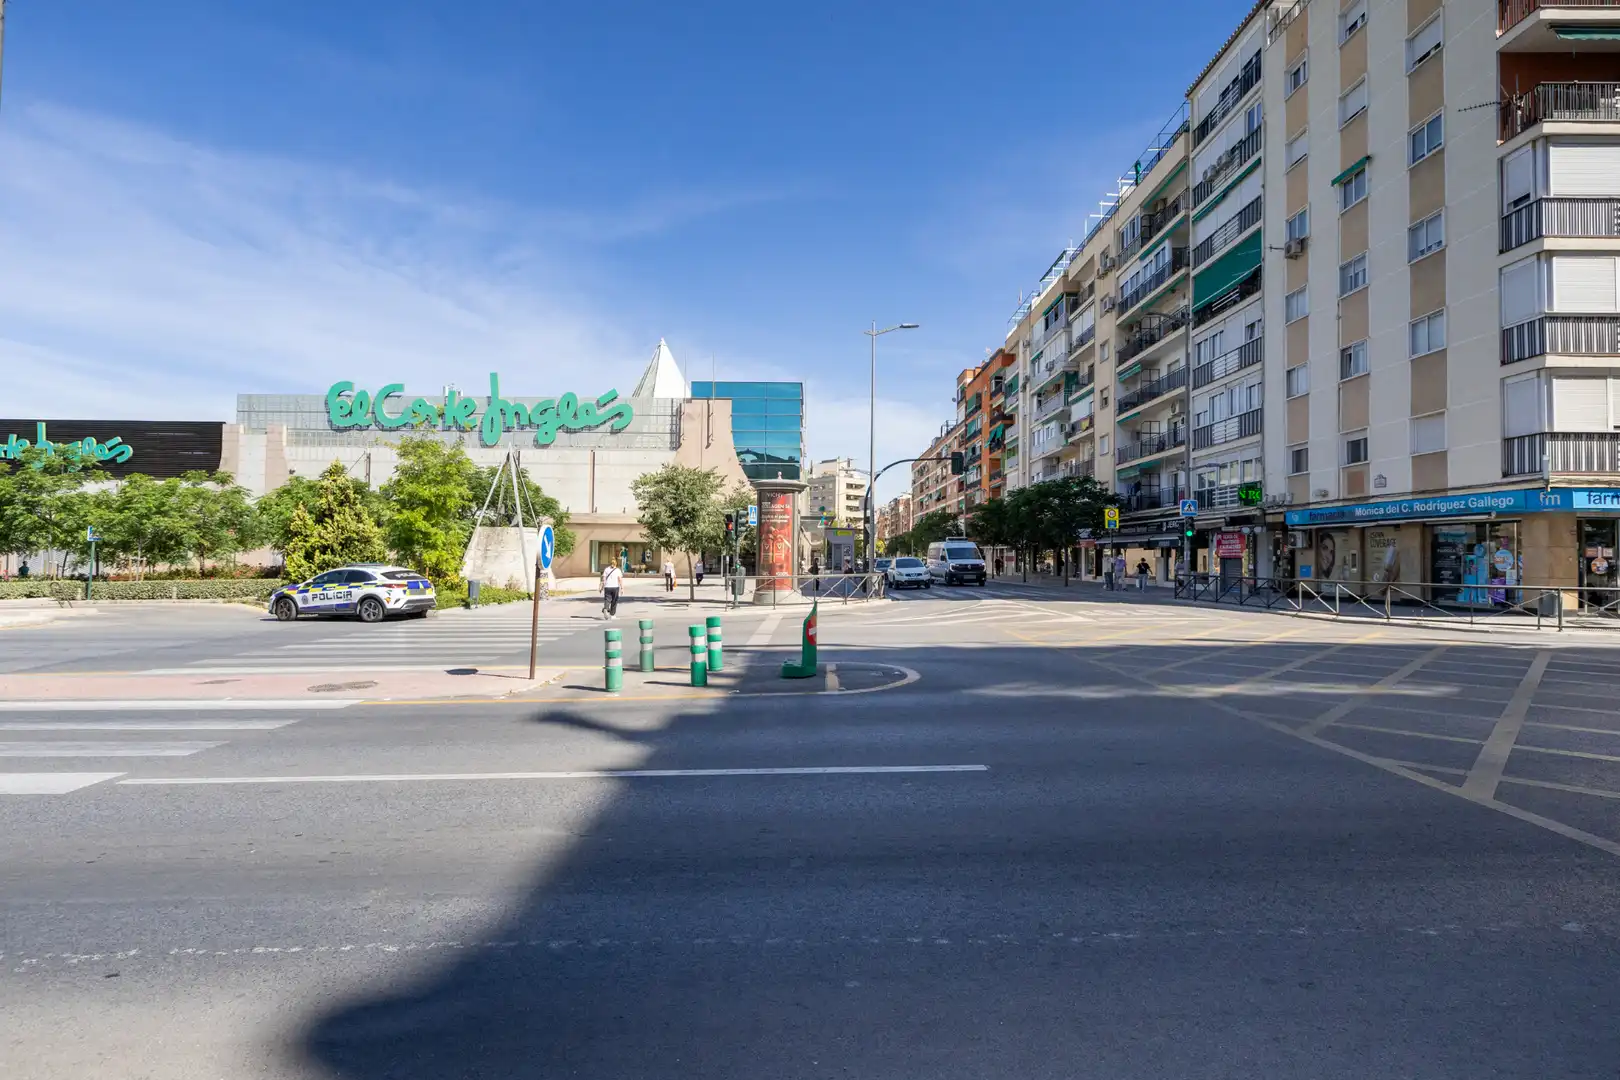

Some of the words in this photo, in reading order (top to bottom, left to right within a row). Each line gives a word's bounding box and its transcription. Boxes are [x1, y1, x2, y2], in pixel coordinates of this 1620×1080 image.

[326, 380, 372, 428] El
[374, 383, 478, 429] Corte
[1386, 504, 1399, 514] del
[1401, 503, 1411, 513] C.
[1468, 496, 1514, 509] Gallego
